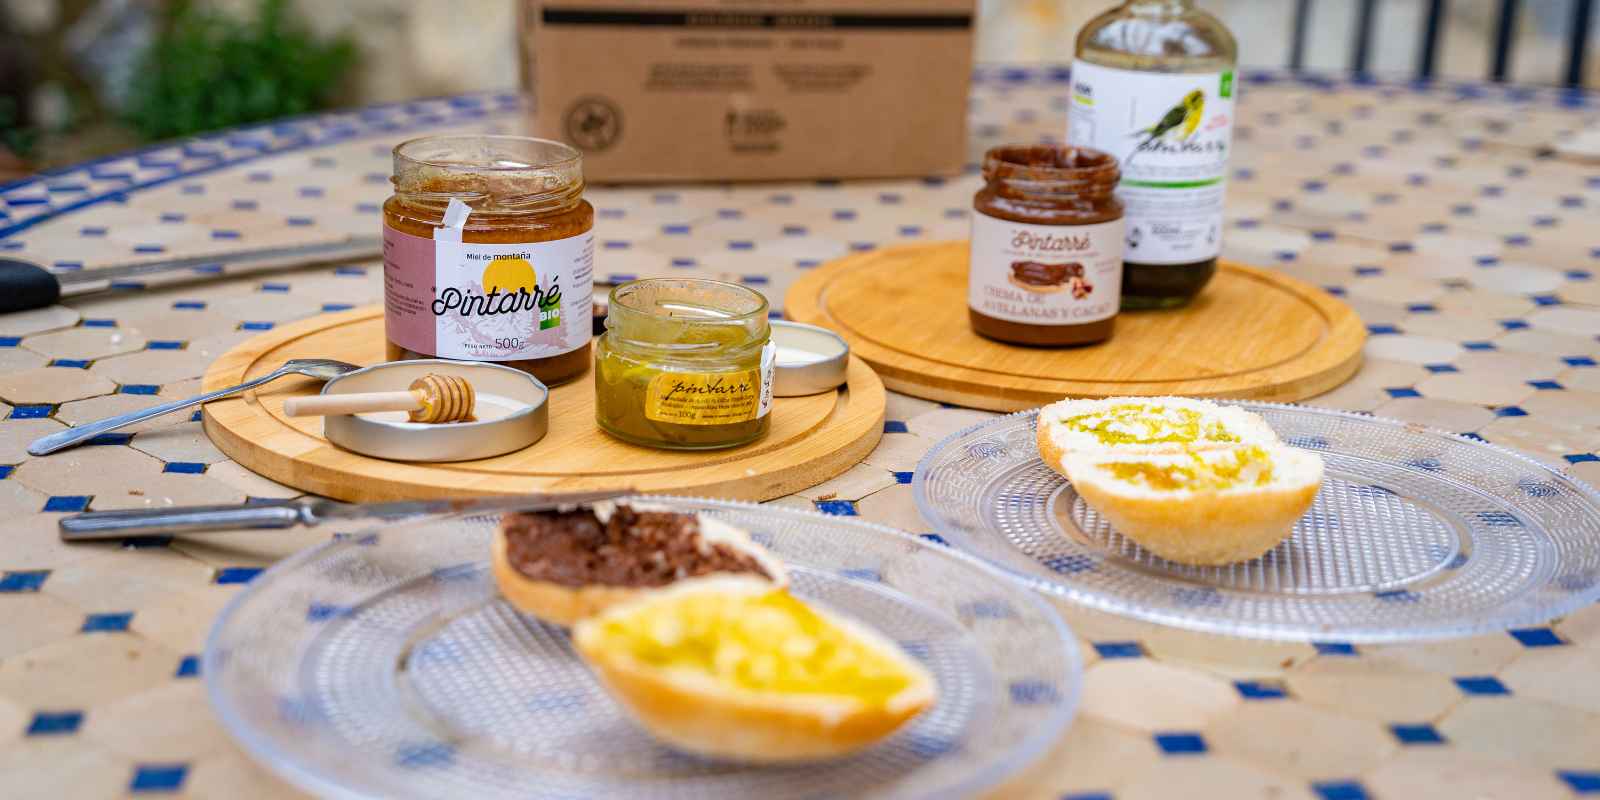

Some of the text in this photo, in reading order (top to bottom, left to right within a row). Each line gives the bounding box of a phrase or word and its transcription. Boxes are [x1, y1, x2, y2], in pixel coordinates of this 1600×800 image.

[466, 251, 531, 261] Miel de montaña
[431, 275, 562, 316] Pintarré
[984, 284, 1023, 302] CREMA
[539, 308, 560, 322] BIO
[495, 337, 525, 350] 500g
